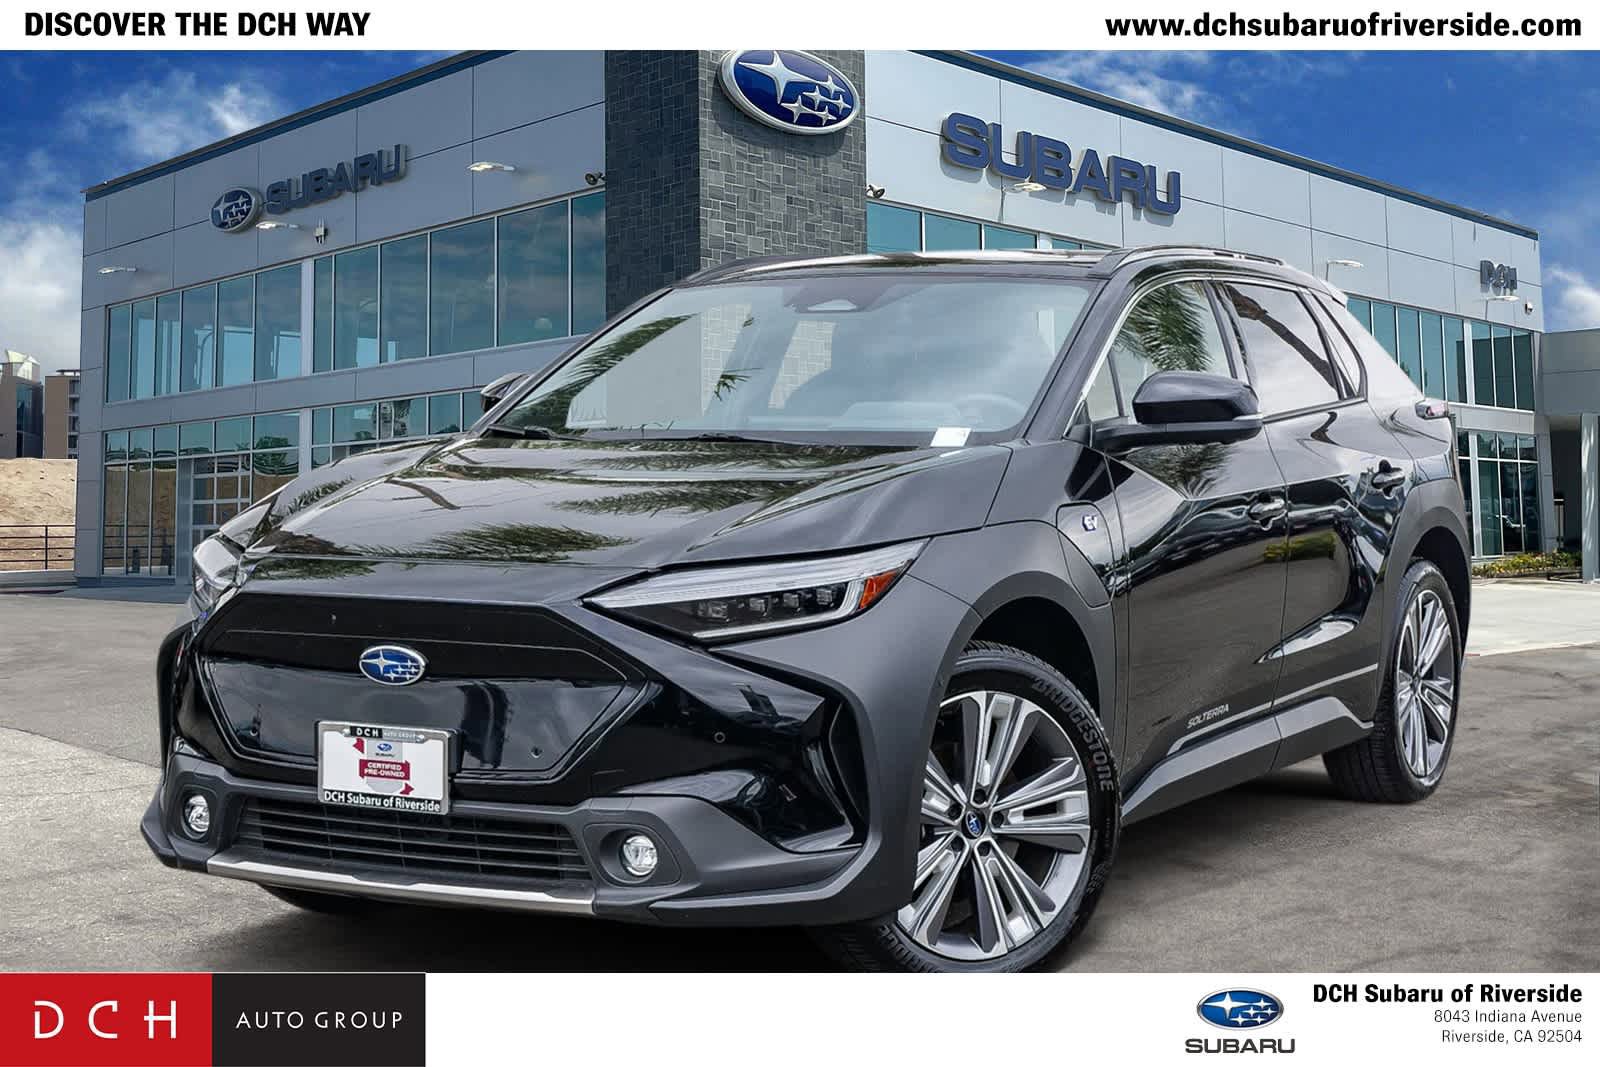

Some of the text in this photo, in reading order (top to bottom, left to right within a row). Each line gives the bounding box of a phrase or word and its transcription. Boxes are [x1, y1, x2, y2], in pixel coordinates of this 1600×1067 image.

[943, 112, 1182, 215] SUBARU
[266, 144, 406, 215] SUBARU
[1186, 703, 1230, 729] SOLTERRA
[356, 727, 379, 737] DCH
[1032, 676, 1114, 792] BRIDGESTONE
[364, 768, 405, 778] PRE-OWNED
[367, 761, 402, 771] CERTIFIED
[324, 790, 440, 812] DCH Subaru of Riverside
